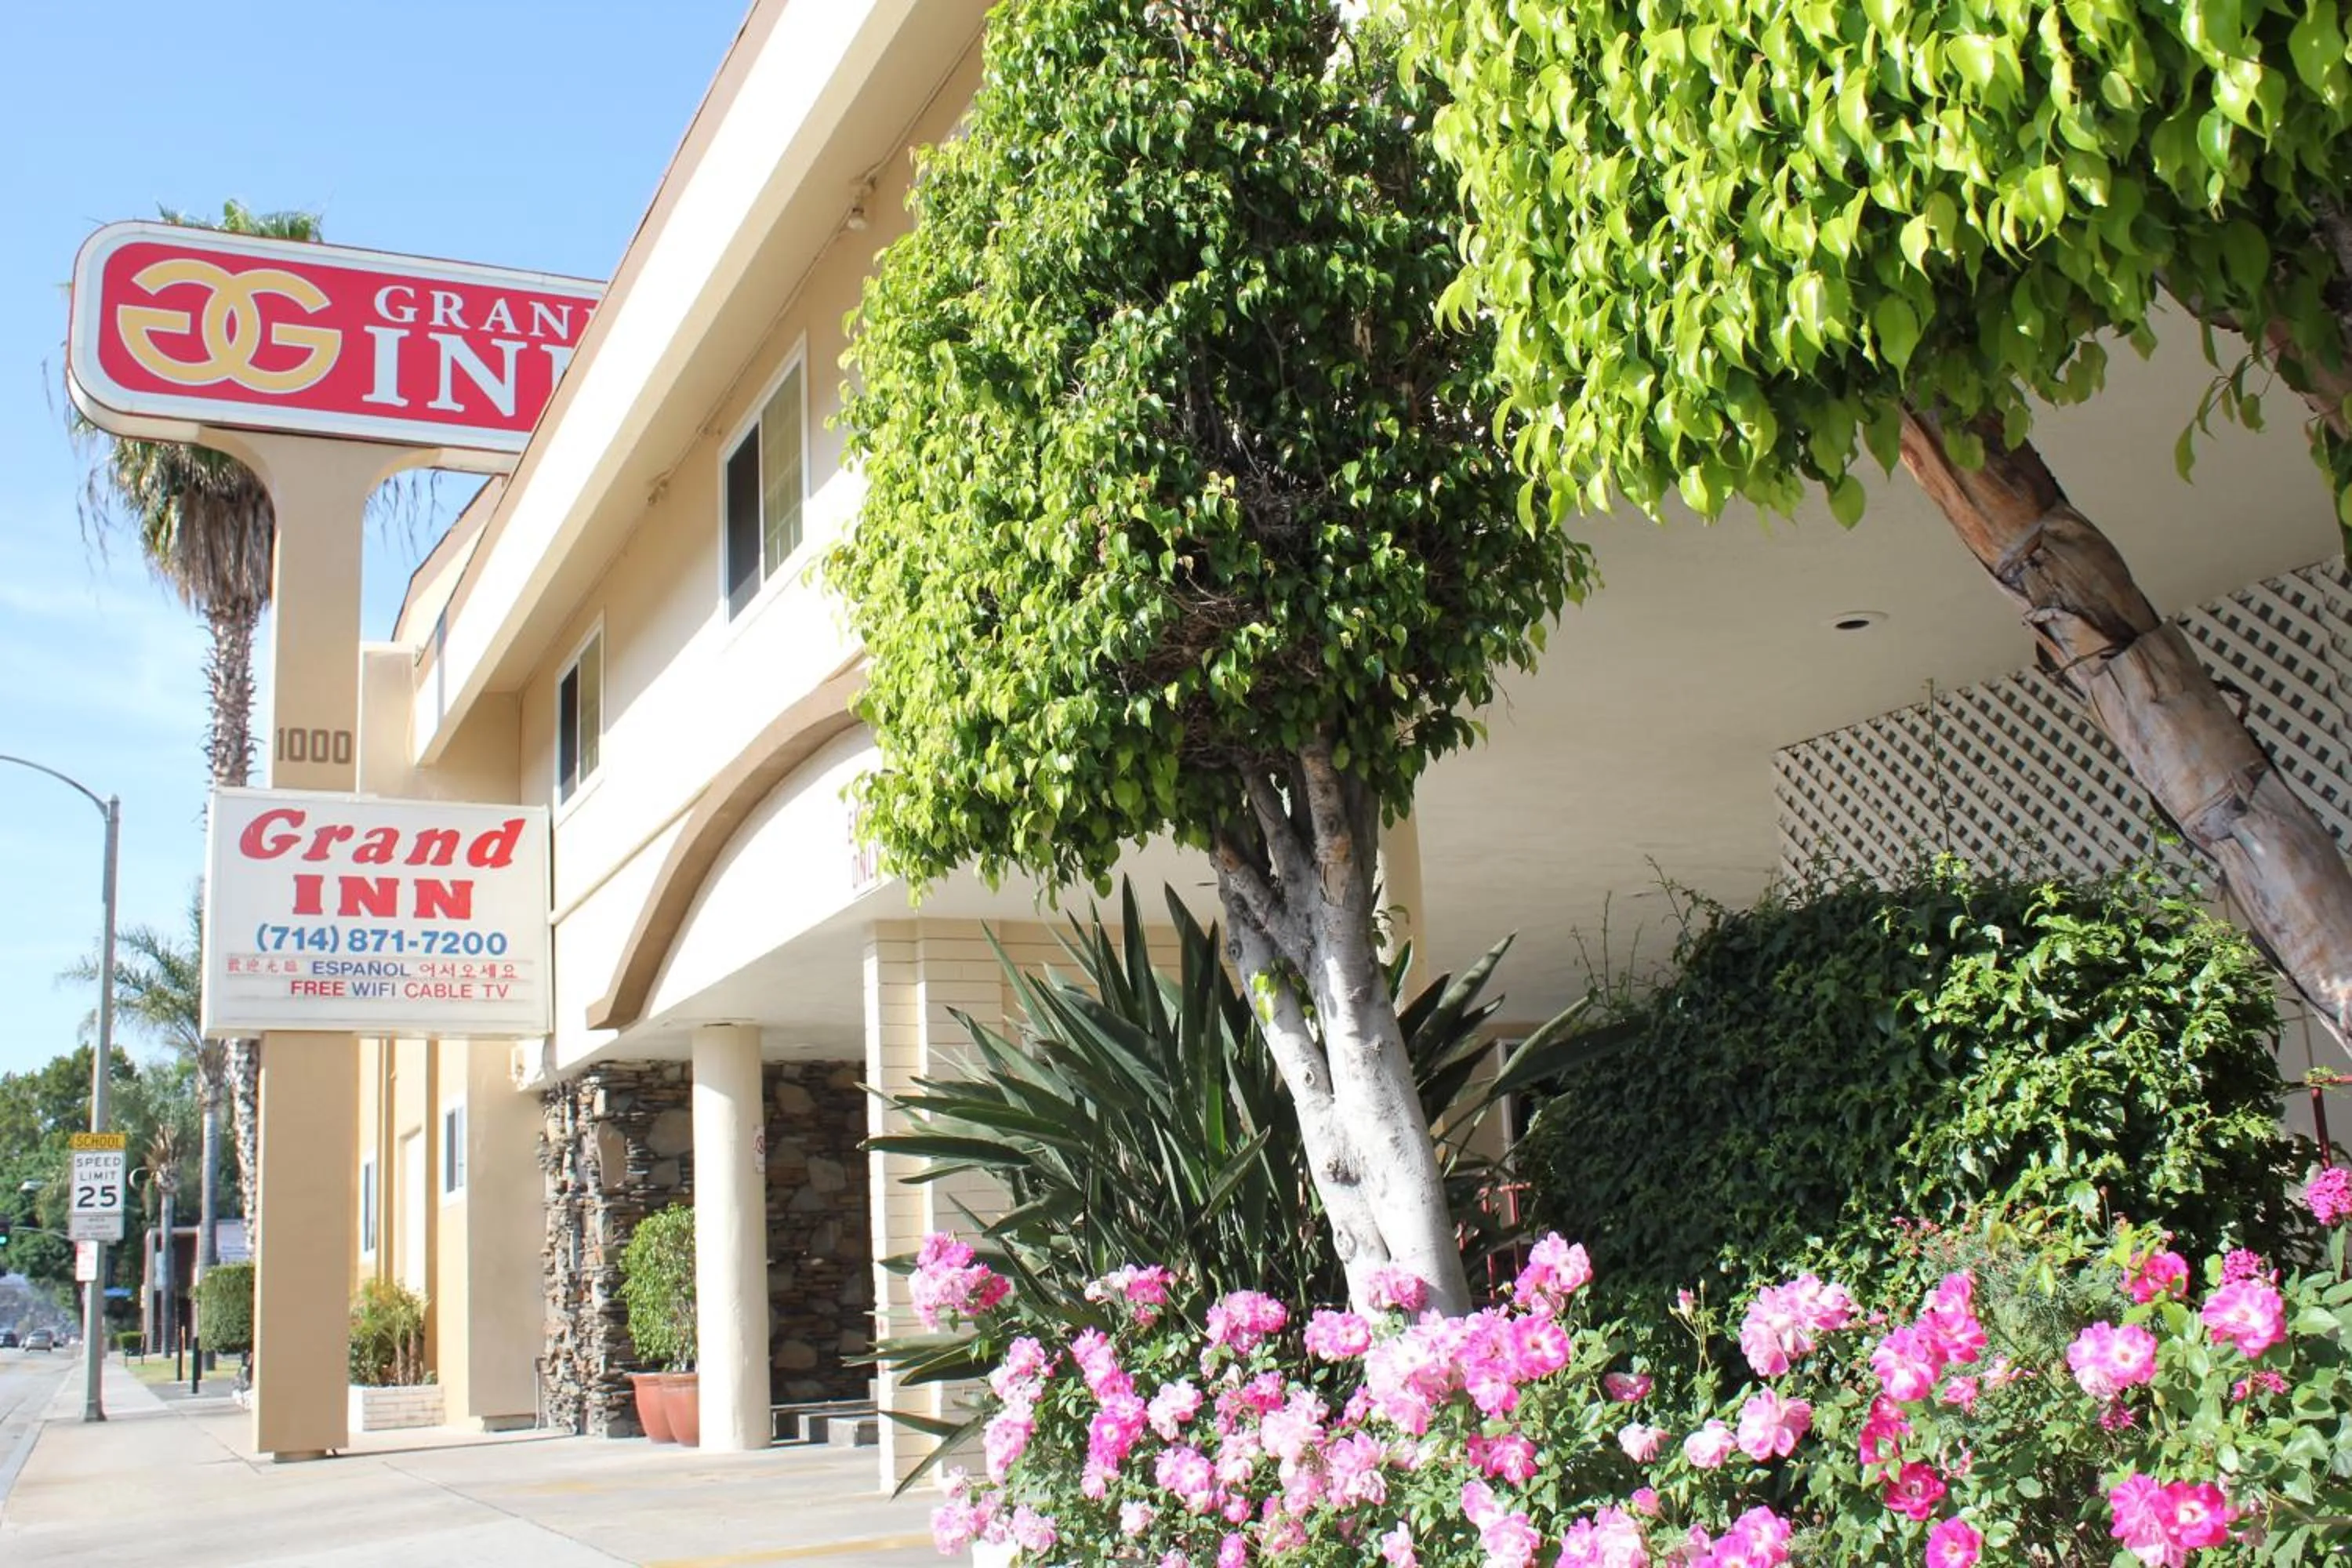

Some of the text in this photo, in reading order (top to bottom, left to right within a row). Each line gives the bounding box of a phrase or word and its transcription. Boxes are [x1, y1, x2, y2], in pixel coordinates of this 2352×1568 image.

[373, 285, 597, 340] GRAN
[278, 728, 352, 764] 1000
[238, 808, 526, 869] Grand
[292, 874, 474, 920] INN
[256, 923, 507, 956] (714) 871-7200
[312, 959, 411, 977] ESPAÑOL
[291, 980, 509, 999] FREE WIFI CABLE TV
[77, 1136, 121, 1148] SCHOOL
[76, 1156, 122, 1167] SPEED
[80, 1171, 117, 1181] LIMIT
[77, 1185, 117, 1208] 25
